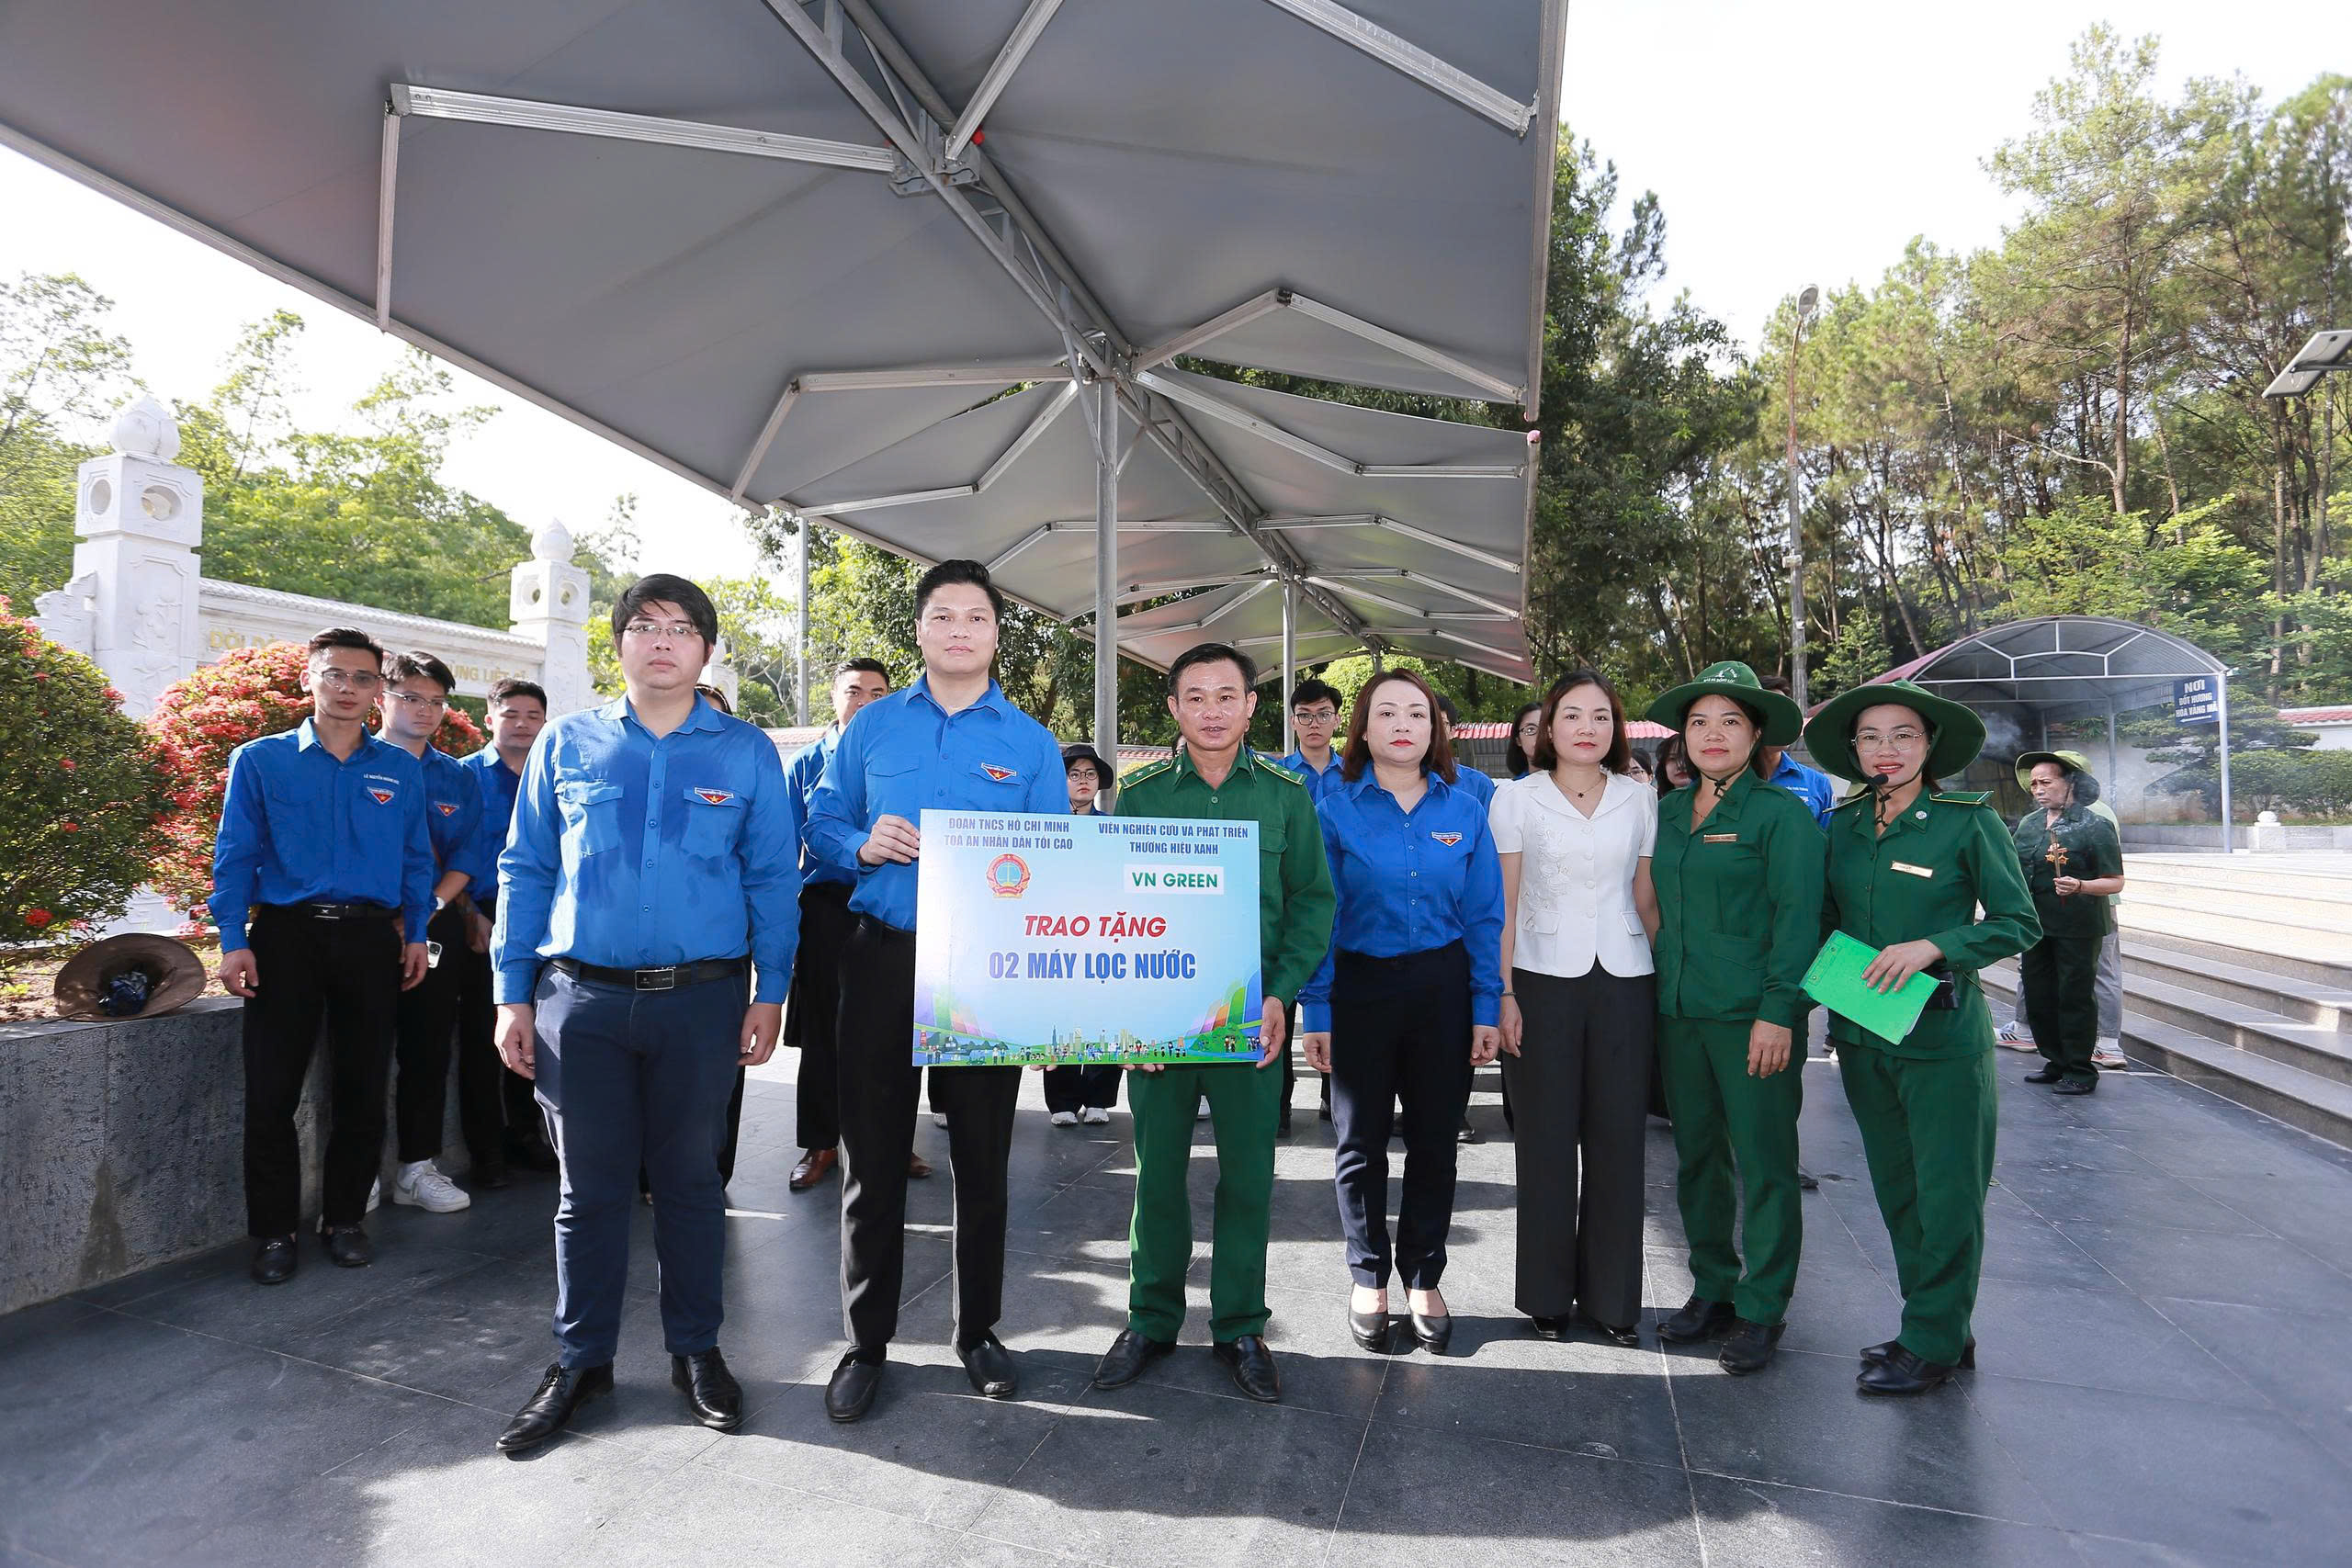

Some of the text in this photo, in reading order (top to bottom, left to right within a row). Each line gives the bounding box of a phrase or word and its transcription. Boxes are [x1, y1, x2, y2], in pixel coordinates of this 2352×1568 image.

[978, 818, 1004, 830] TNCS
[1044, 821, 1069, 832] MINH
[1053, 838, 1073, 850] CAO
[1193, 843, 1218, 854] XANH
[1131, 872, 1218, 888] VN GREEN
[1024, 911, 1167, 943] TRAO TẶNG
[989, 949, 1196, 984] 02 MÁY LỌC NƯỚC
